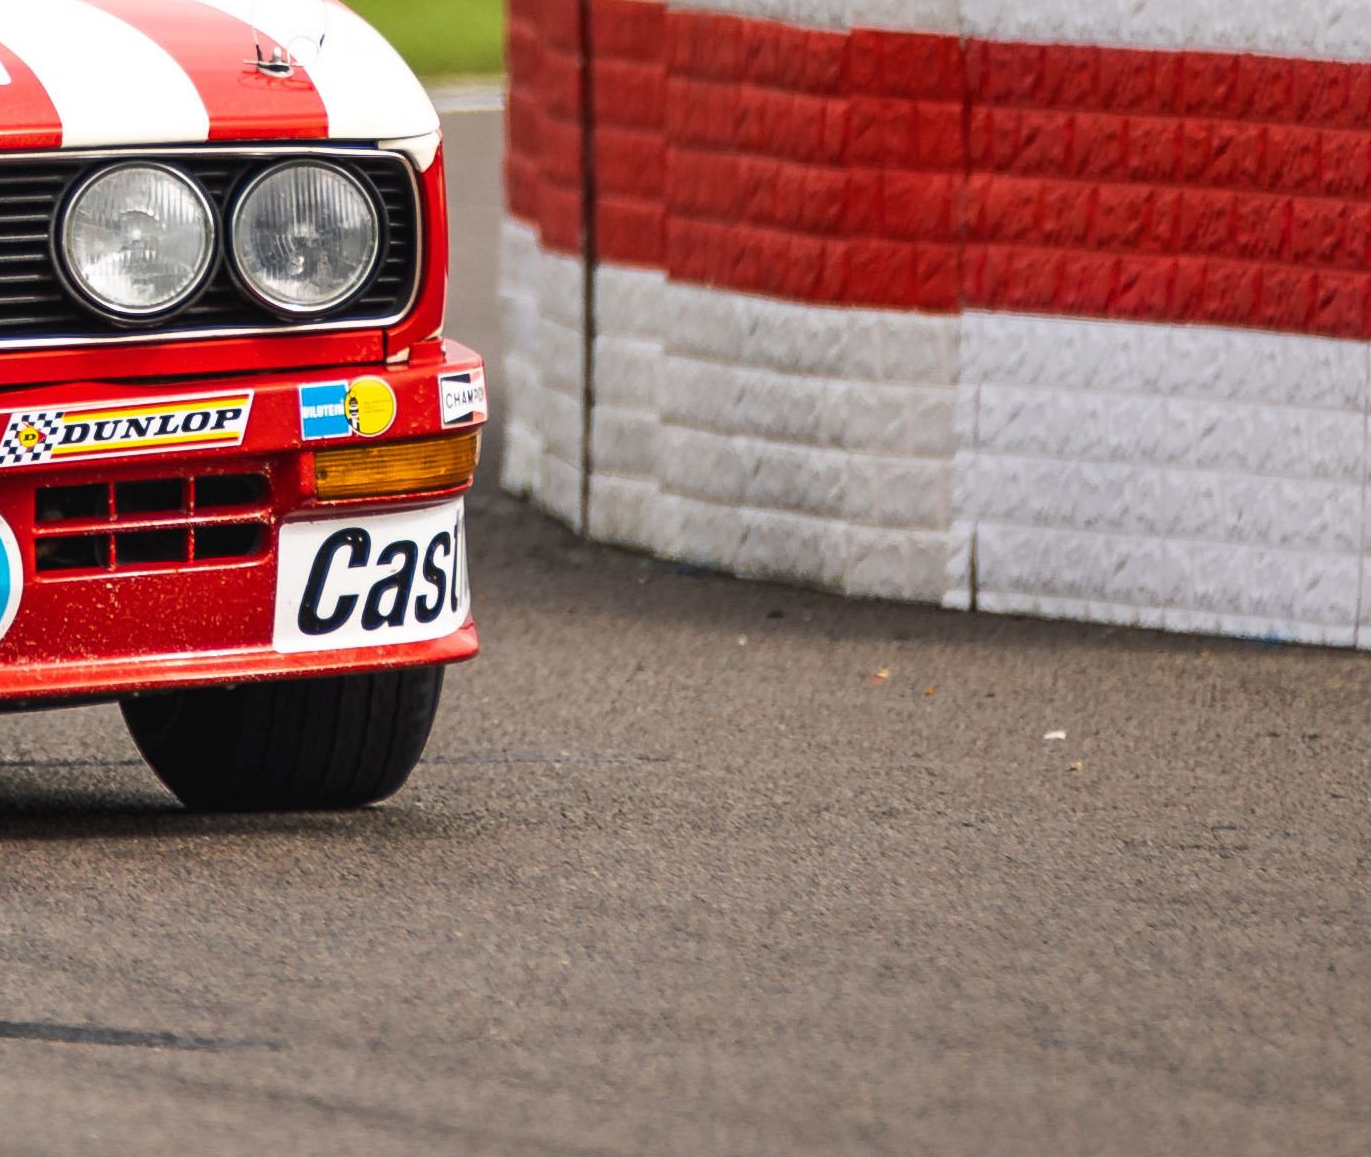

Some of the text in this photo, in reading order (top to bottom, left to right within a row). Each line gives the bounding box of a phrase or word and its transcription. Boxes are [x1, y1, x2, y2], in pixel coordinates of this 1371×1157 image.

[59, 408, 242, 444] DUNLOP
[302, 404, 346, 420] BILSTEIN
[297, 516, 467, 636] Cast
